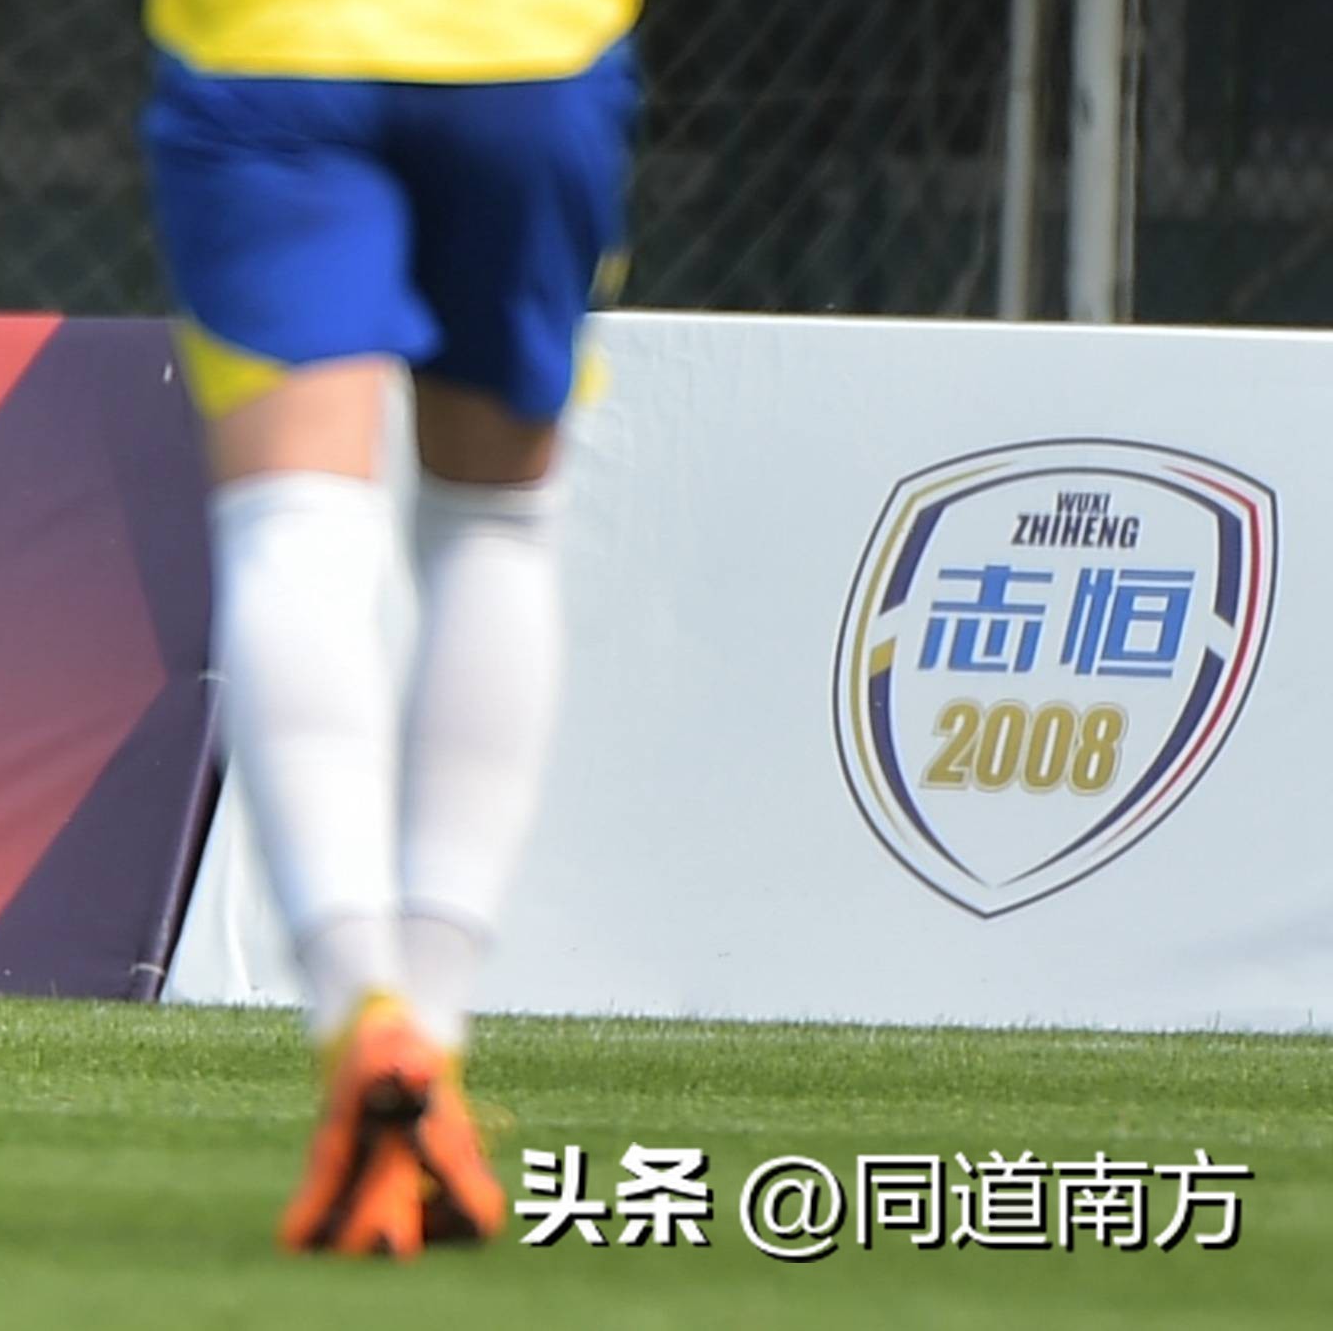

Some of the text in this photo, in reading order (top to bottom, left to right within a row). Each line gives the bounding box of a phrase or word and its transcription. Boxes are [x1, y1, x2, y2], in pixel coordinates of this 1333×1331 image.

[1011, 513, 1141, 549] ZHIHENG
[1055, 491, 1111, 515] WUXI
[918, 565, 1196, 679] 志恒
[921, 698, 1128, 794] 2008
